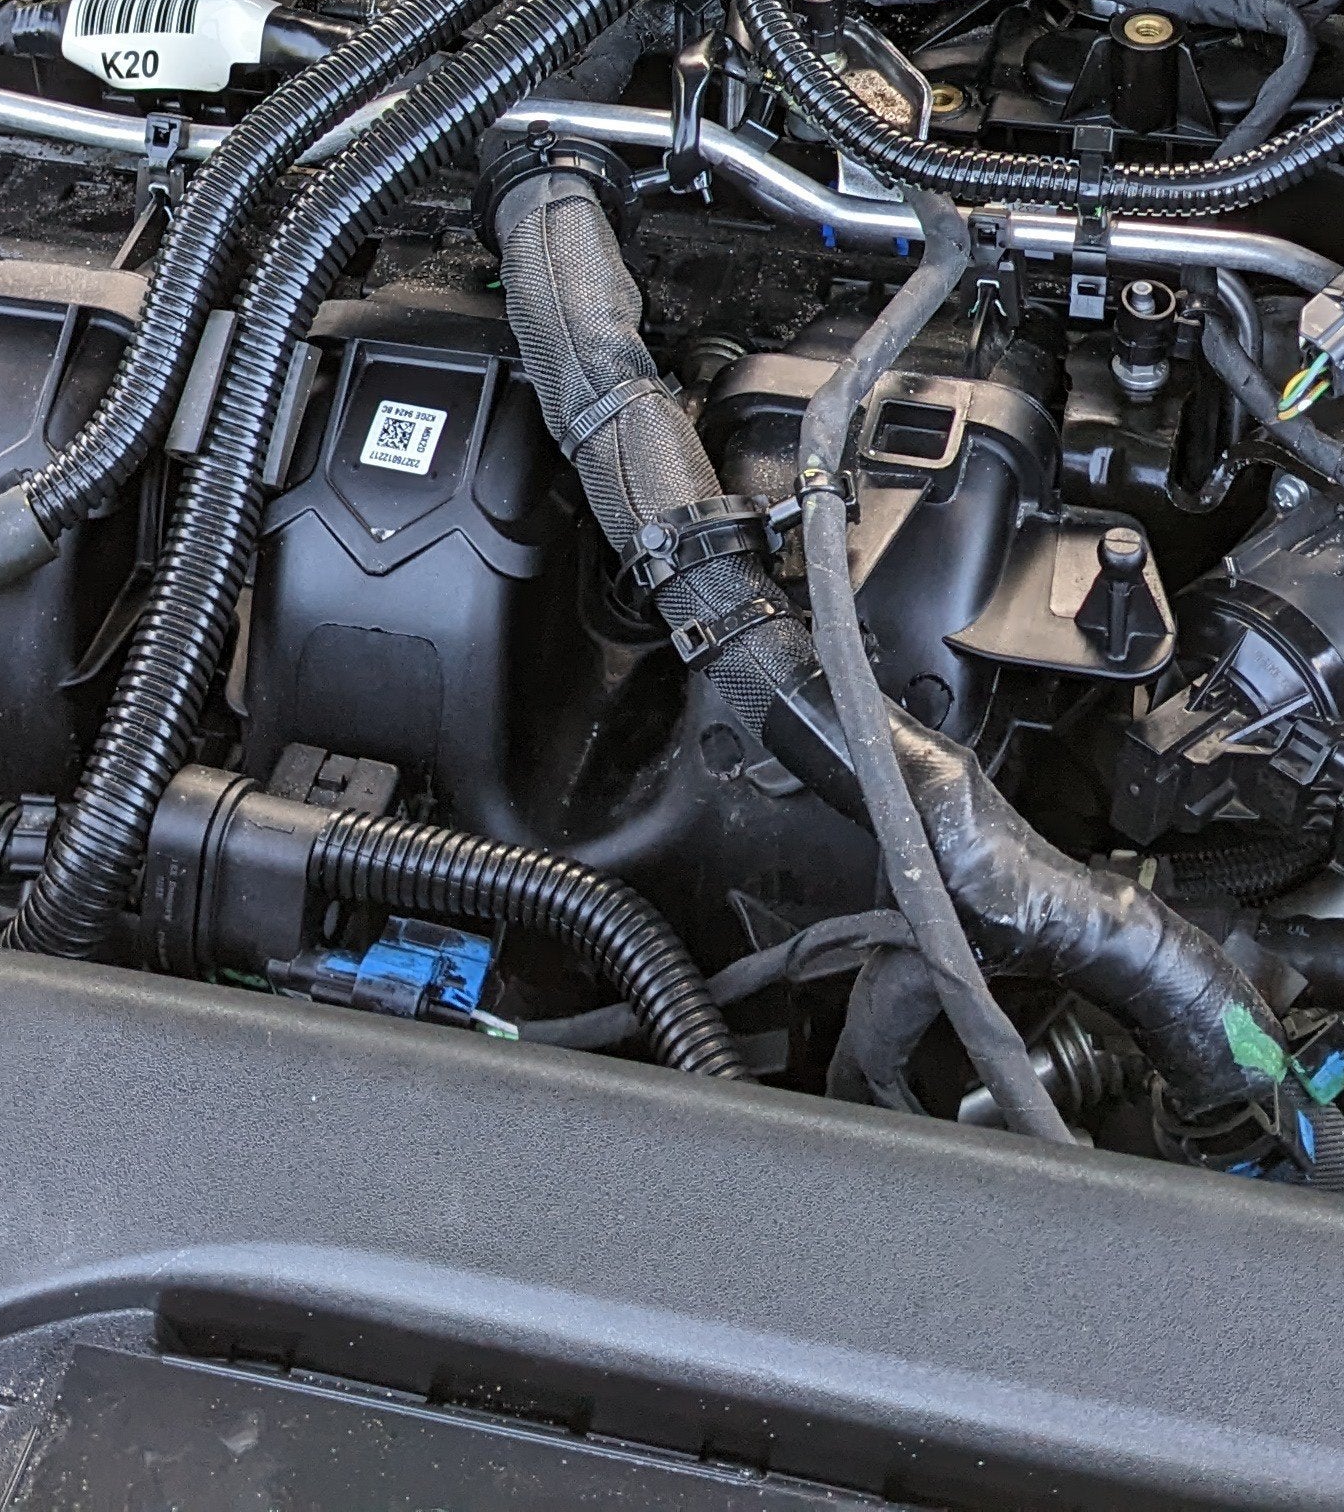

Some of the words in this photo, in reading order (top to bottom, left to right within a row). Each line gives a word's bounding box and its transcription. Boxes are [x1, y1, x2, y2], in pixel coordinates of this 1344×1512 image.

[101, 49, 160, 80] K20
[394, 407, 415, 419] 9424
[414, 411, 438, 423] K2GE
